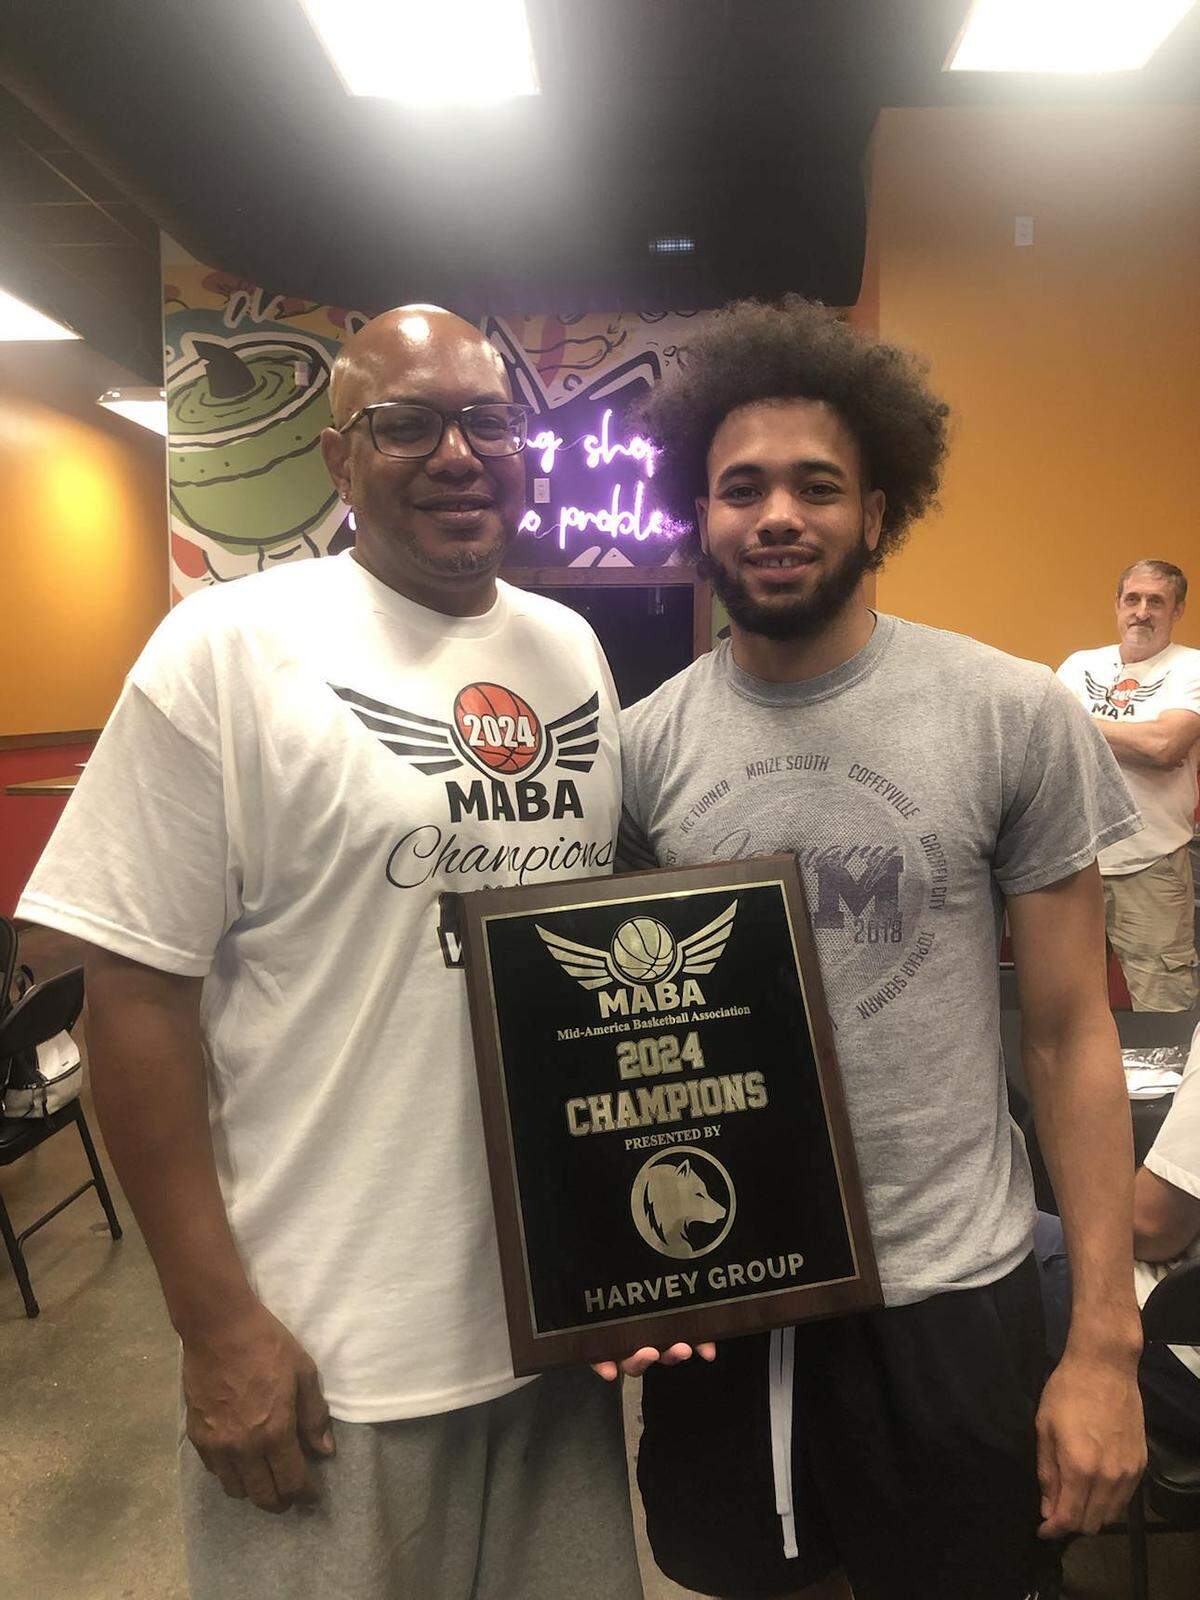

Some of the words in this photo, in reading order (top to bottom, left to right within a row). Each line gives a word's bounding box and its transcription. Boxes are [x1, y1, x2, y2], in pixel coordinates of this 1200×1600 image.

[558, 480, 682, 550] proble
[463, 714, 536, 748] 2024
[1091, 703, 1135, 720] MAA
[745, 757, 782, 780] MAIZE
[786, 754, 830, 771] SOUTH
[445, 780, 584, 823] MABA
[690, 779, 731, 819] TURNER
[847, 763, 920, 821] COFFEYVILLE
[920, 833, 948, 884] GARDEN
[928, 886, 948, 911] CITY
[854, 919, 903, 943] 2018
[900, 931, 935, 978] TOPEKA
[597, 979, 707, 1019] MABA
[856, 975, 908, 1020] SEAMAN
[557, 1022, 631, 1041] Mid-America
[633, 1012, 690, 1031] Basketball
[691, 1005, 751, 1022] Association
[616, 1031, 706, 1081] 2024
[566, 1070, 769, 1137] CHAMPIONS
[624, 1128, 702, 1150] PRESENTED
[703, 1124, 722, 1138] BY
[584, 1271, 700, 1313] HARVEY
[708, 1252, 806, 1290] GROUP
